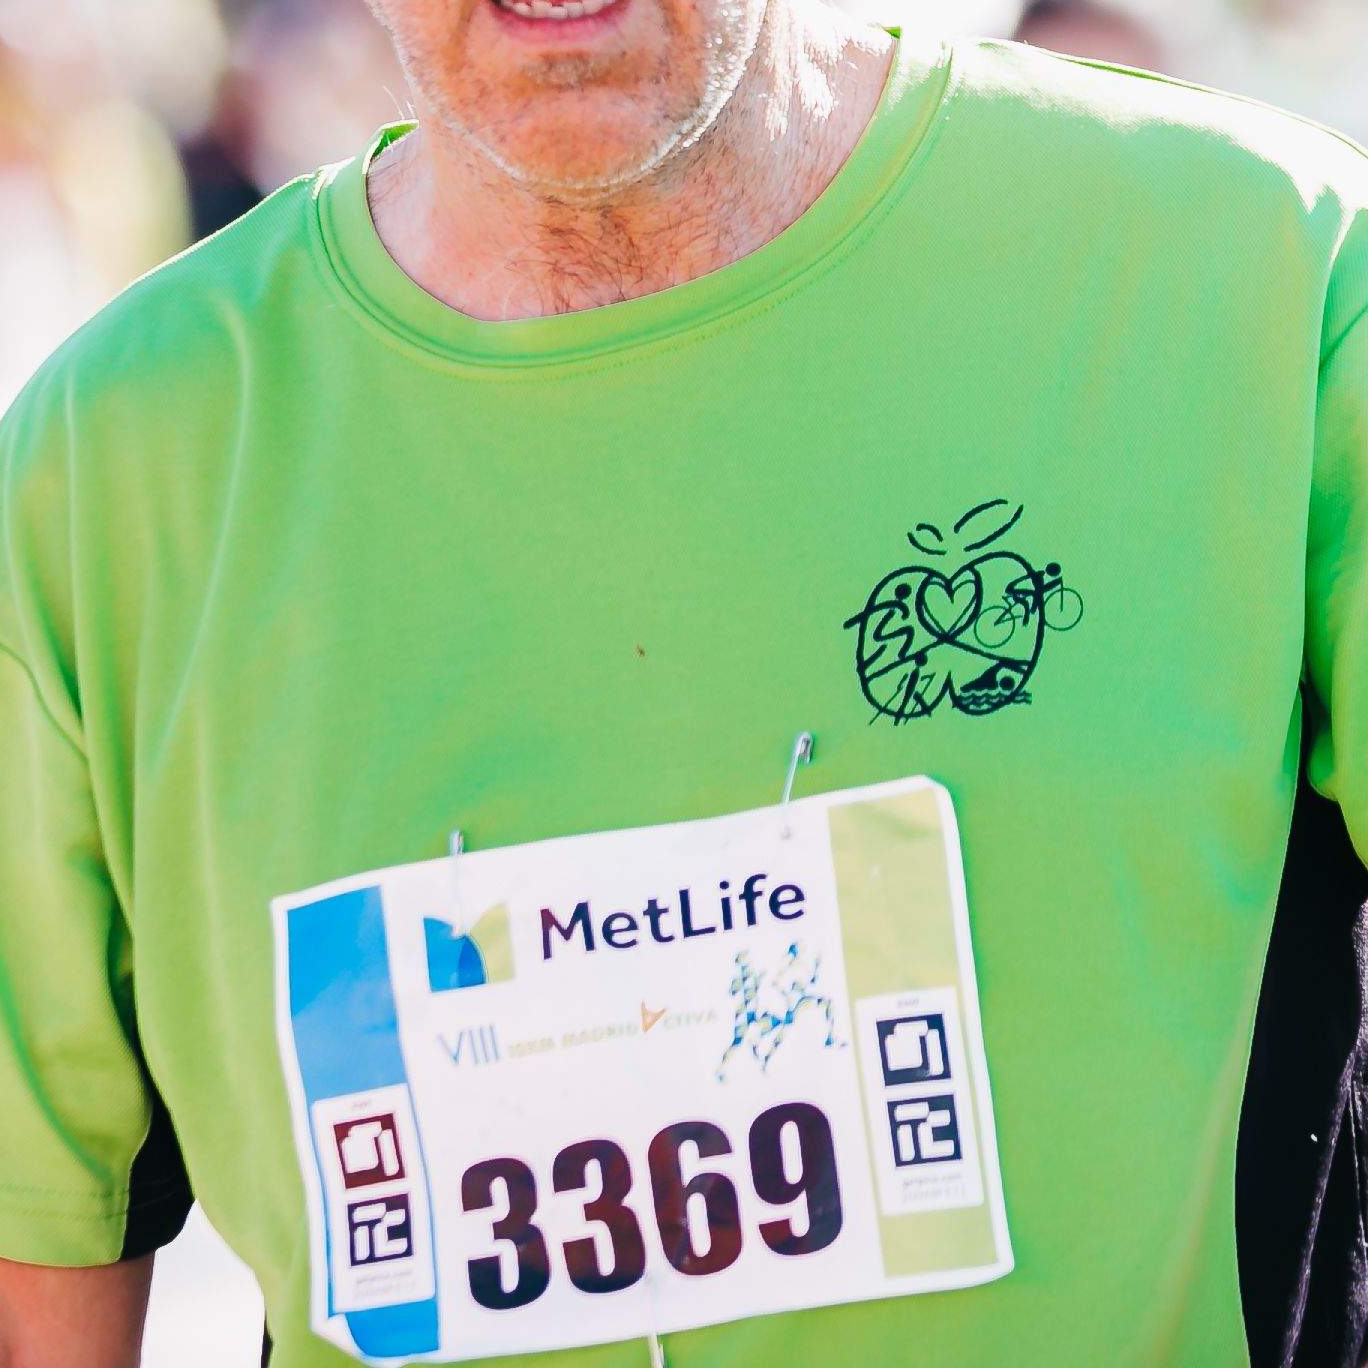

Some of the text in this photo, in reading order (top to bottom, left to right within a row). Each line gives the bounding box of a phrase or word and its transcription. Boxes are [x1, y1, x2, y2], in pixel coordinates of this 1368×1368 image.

[539, 872, 806, 961] MetLife
[438, 1023, 500, 1066] VIII
[460, 1100, 844, 1312] 3369
